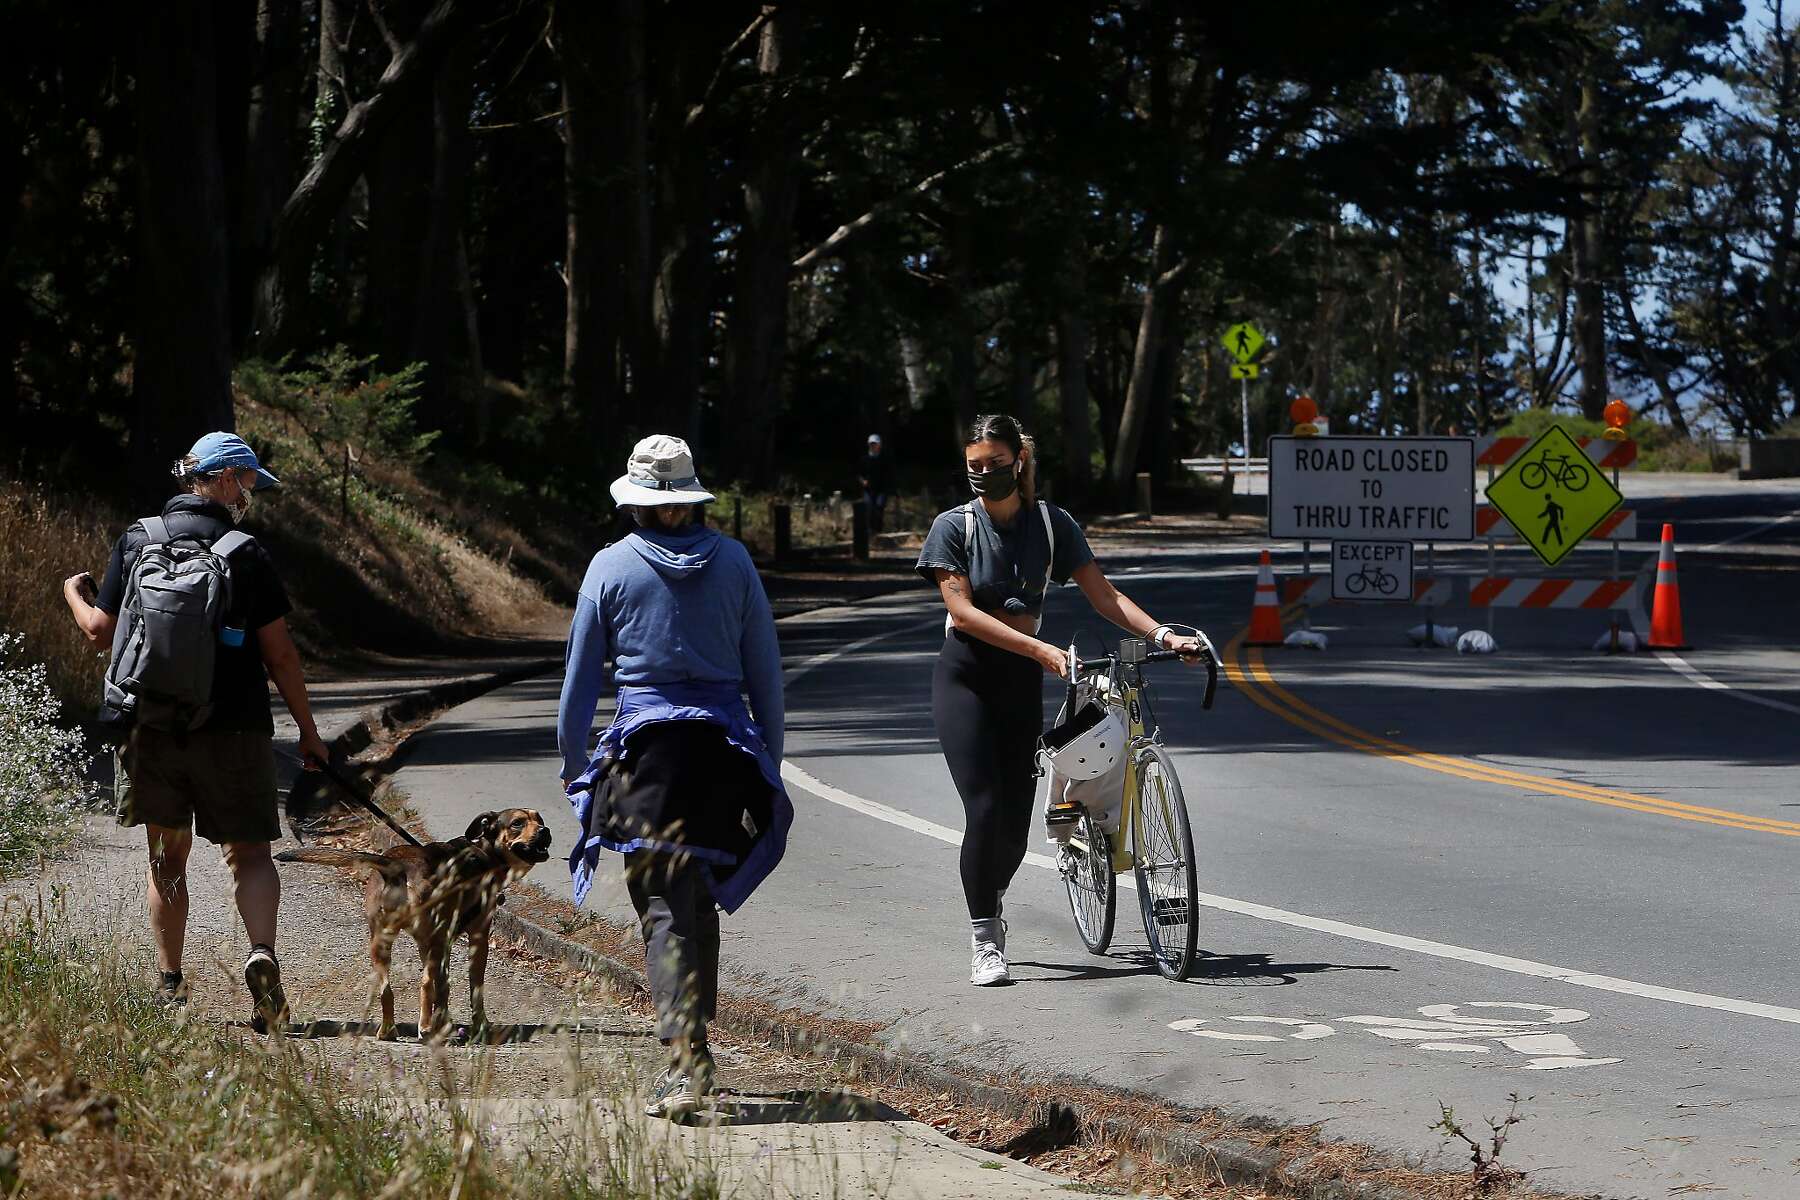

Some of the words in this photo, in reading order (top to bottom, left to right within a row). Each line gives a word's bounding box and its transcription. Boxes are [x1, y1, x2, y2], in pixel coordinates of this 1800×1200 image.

[1295, 449, 1354, 472] ROAD
[1363, 449, 1449, 472] CLOSED
[1360, 479, 1383, 499] TO
[1293, 506, 1352, 528] THRU
[1358, 506, 1450, 529] TRAFFIC
[1340, 545, 1405, 561] EXCEPT
